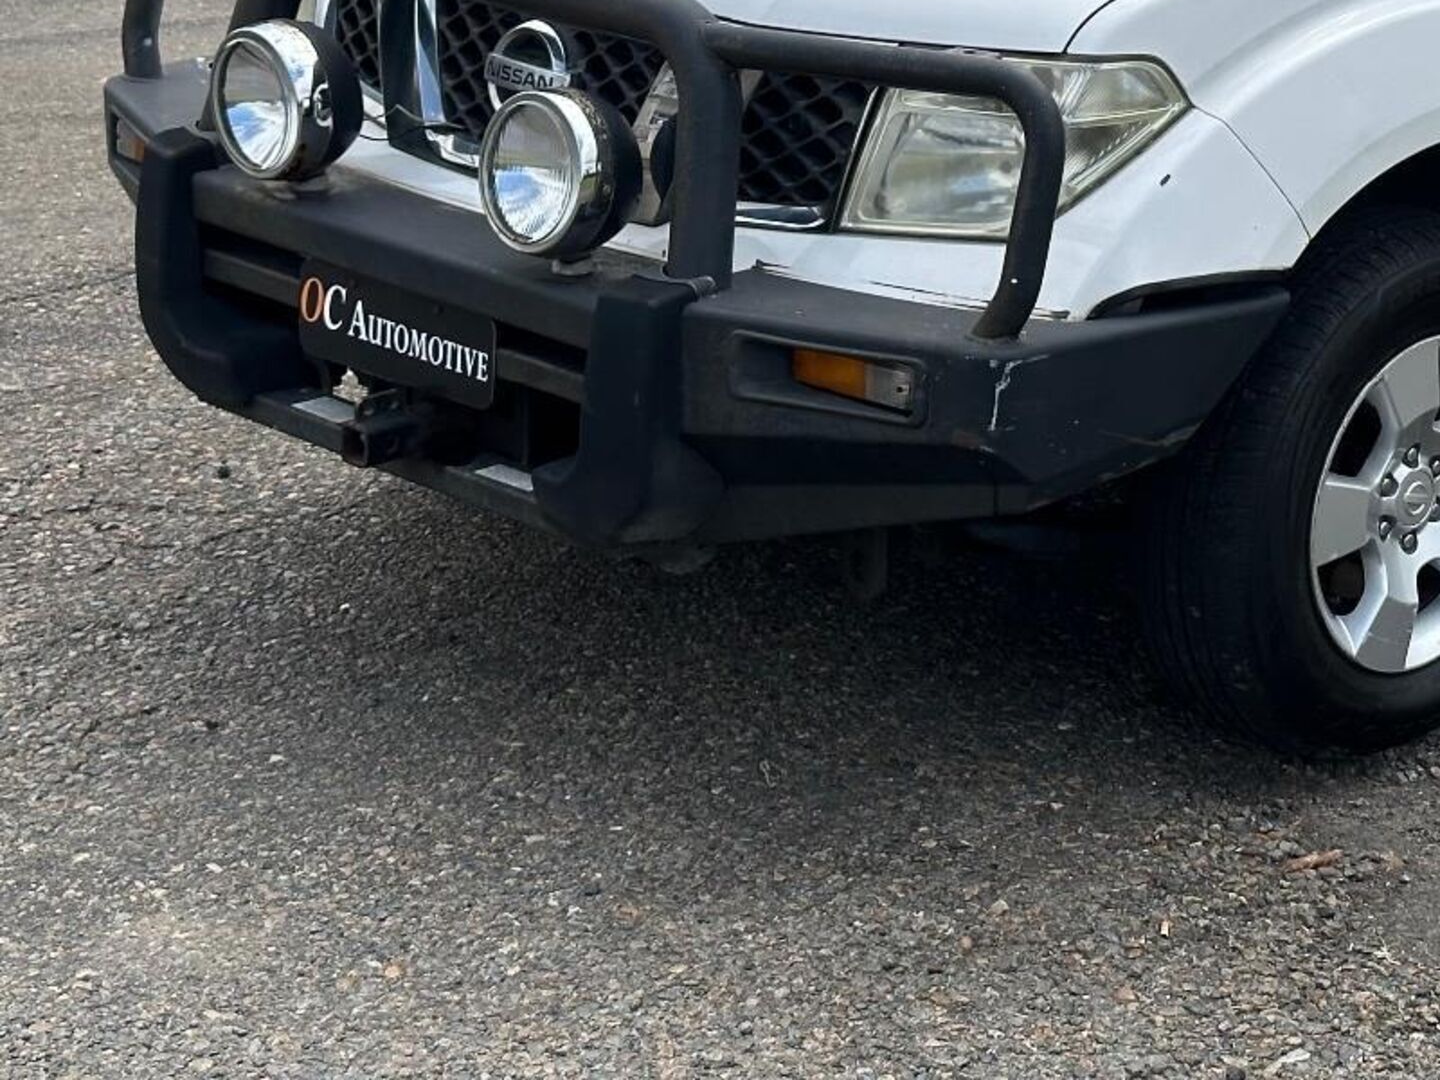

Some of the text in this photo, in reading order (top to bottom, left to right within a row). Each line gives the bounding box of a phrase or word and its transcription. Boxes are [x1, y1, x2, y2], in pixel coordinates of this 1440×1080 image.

[486, 60, 554, 89] NISSAN
[300, 276, 489, 383] OC AUTOMOTIVE
